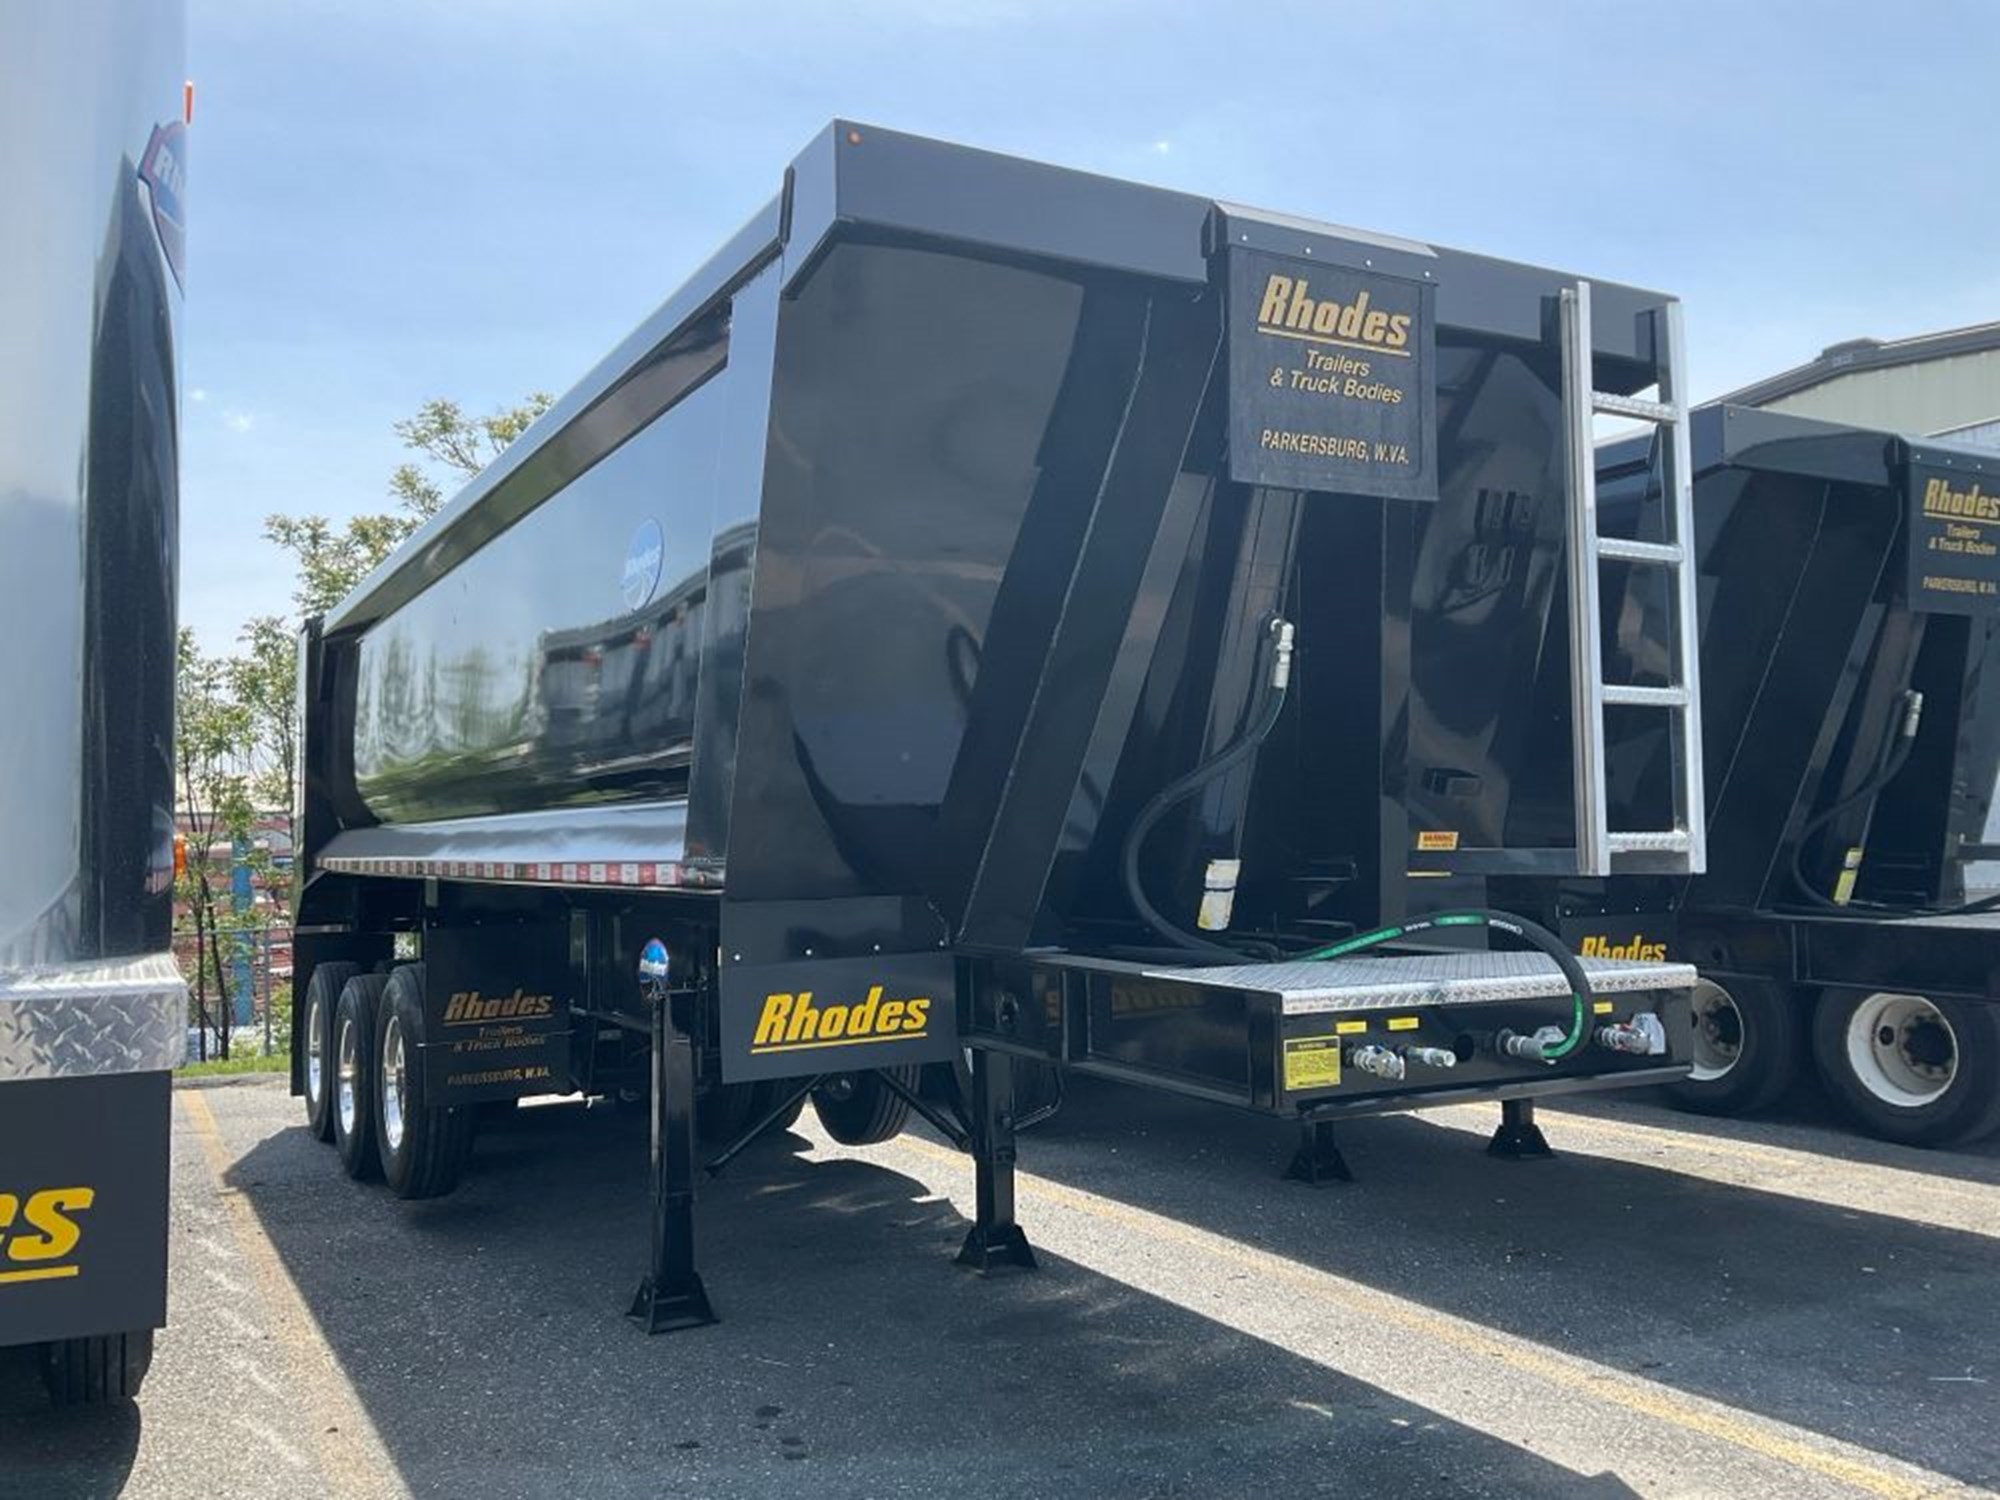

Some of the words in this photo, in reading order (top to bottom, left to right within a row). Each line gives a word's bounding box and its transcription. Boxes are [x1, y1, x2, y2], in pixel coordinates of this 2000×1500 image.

[1258, 274, 1411, 346] Rhodes
[1306, 349, 1370, 378] Trailers
[1270, 368, 1283, 387] &
[1291, 370, 1339, 394] Truck
[1344, 379, 1403, 404] Bodies
[1923, 478, 2000, 519] Rhodes
[1581, 935, 1667, 962] Rhodes
[444, 988, 553, 1020] Rhodes
[753, 986, 930, 1045] Rhodes
